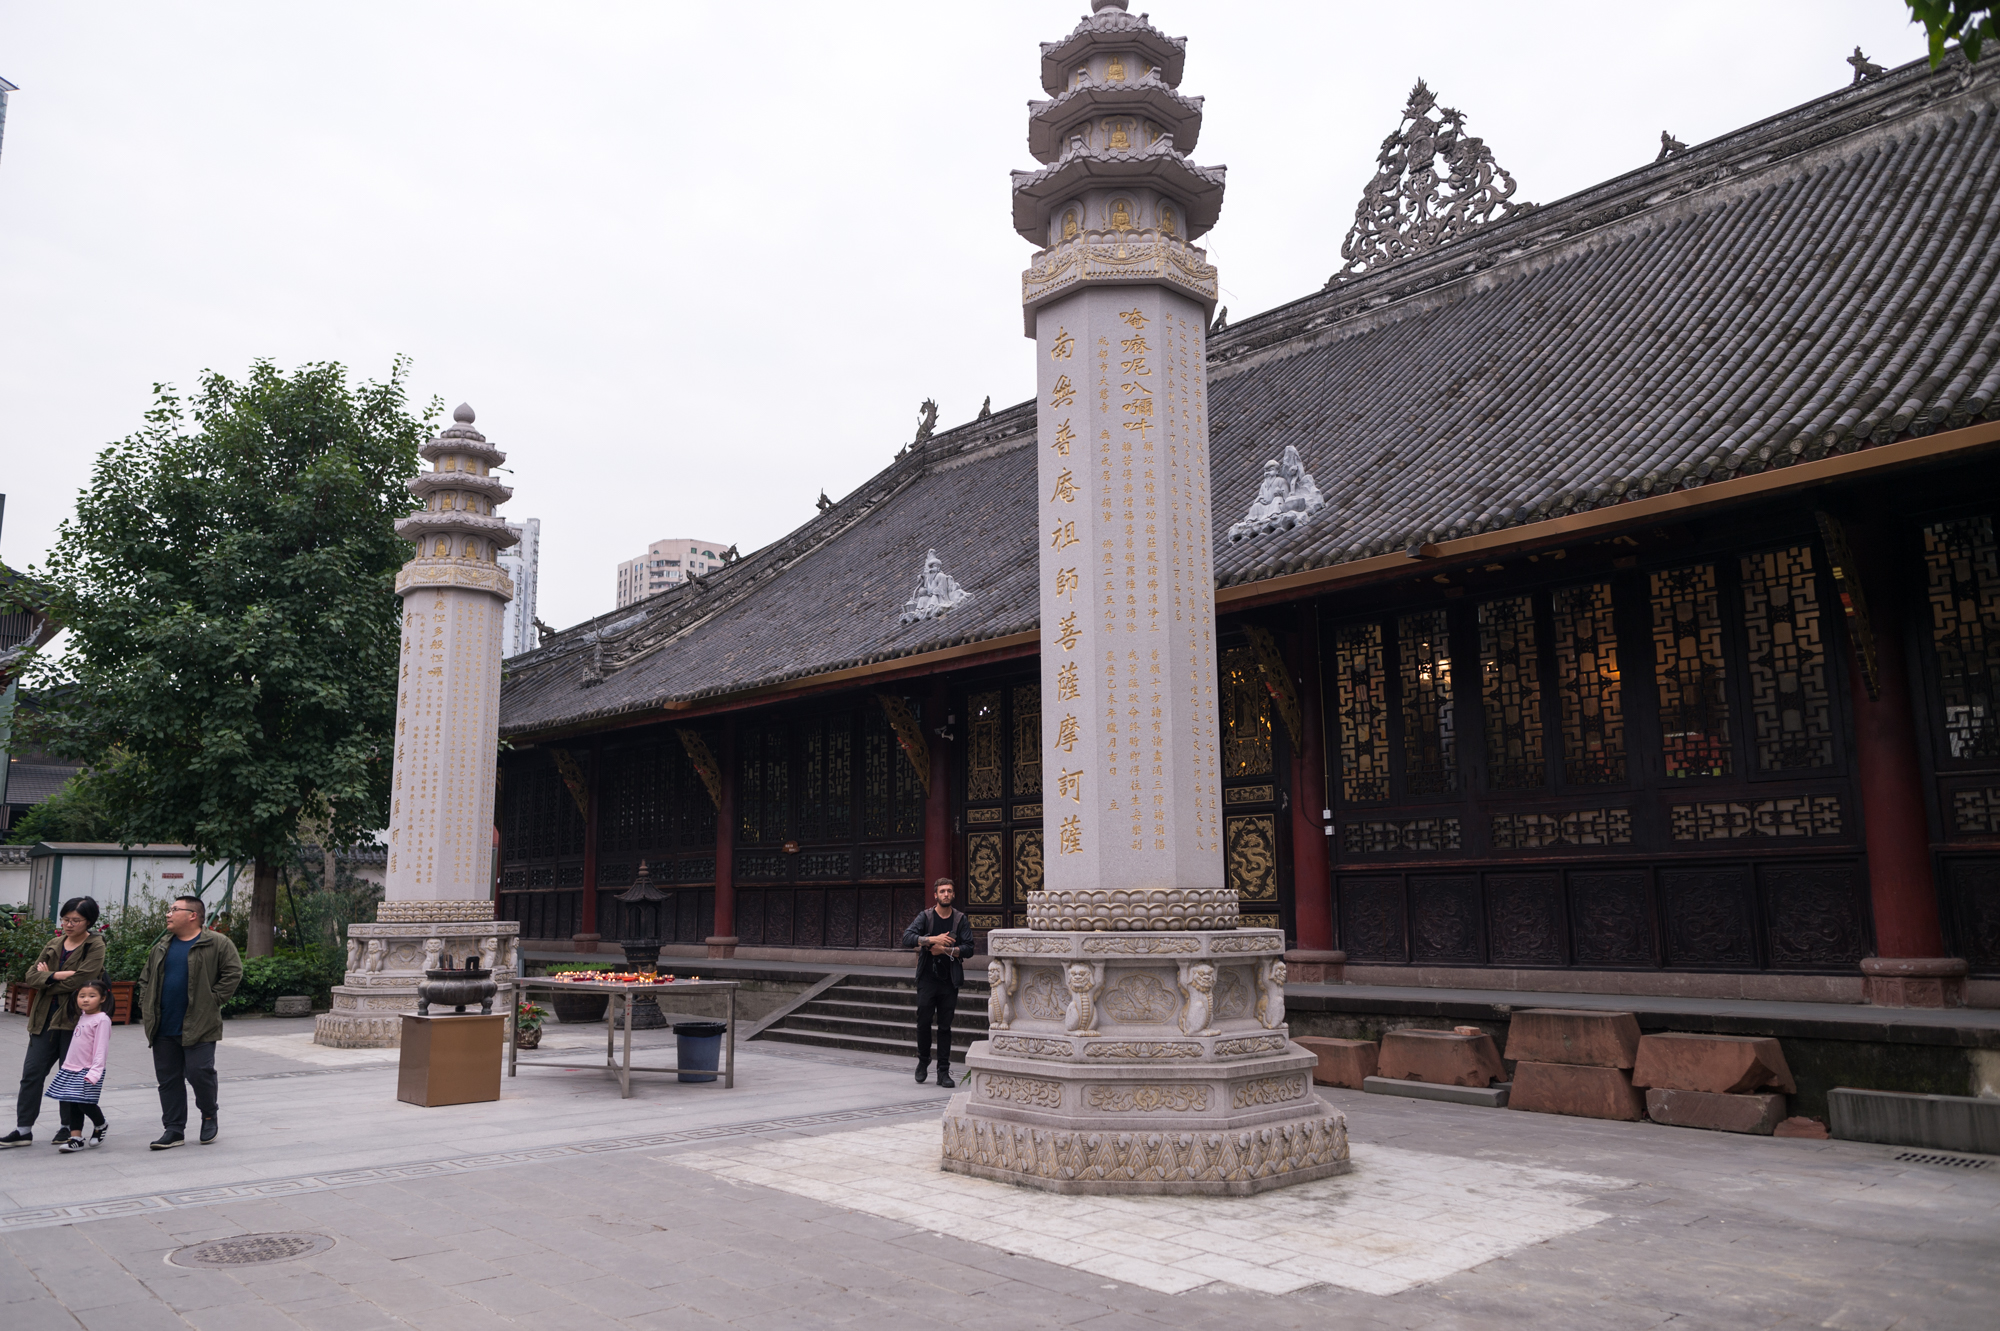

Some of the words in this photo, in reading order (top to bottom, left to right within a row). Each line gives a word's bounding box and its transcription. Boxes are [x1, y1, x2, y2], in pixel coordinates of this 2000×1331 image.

[1097, 336, 1109, 414] 成都市大慈寺
[1099, 429, 1113, 523] 無名氏居士捐資
[1049, 326, 1084, 857] 南無普庵祖師菩薩摩訶薩
[1107, 799, 1120, 811] 立
